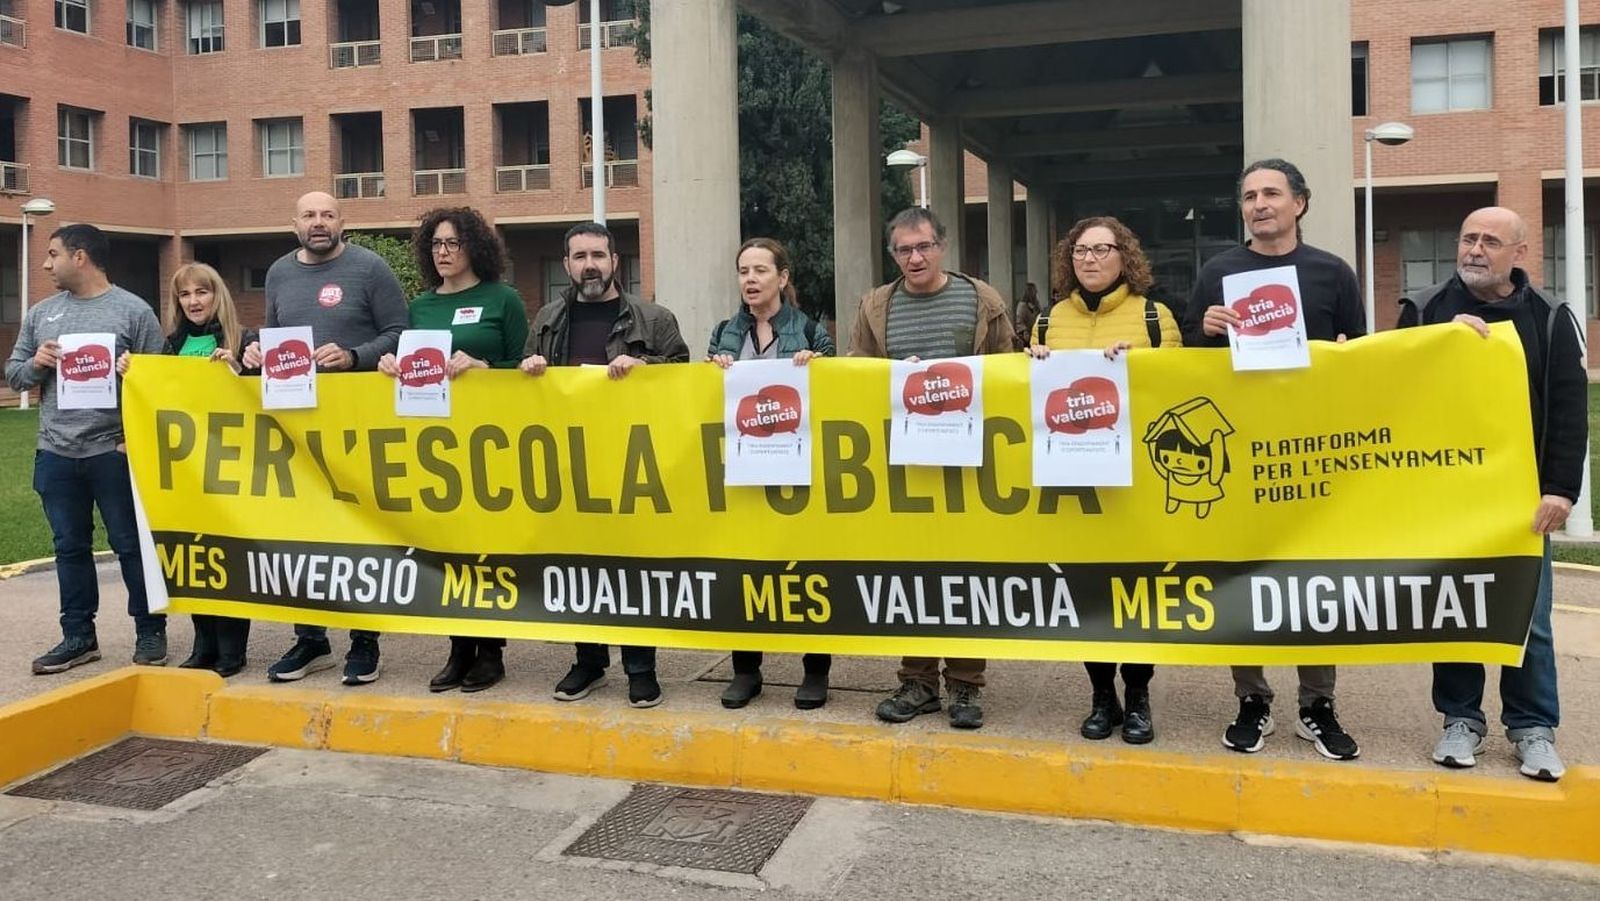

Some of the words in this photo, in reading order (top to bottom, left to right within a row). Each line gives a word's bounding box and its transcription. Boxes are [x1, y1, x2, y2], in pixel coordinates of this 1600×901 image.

[1247, 298, 1275, 314] tria
[74, 353, 95, 365] tria
[277, 350, 296, 362] tria
[411, 358, 431, 369] tria
[65, 360, 109, 375] valencià
[269, 356, 310, 374] valencià
[402, 365, 443, 380] valencià
[923, 376, 951, 390] tria
[909, 385, 970, 406] valencià
[1066, 392, 1095, 408] tria
[755, 399, 781, 413] tria
[1051, 400, 1116, 425] valencià
[741, 407, 798, 428] valencià
[1251, 427, 1392, 457] PLATAFORMA
[156, 409, 296, 498] PER
[305, 423, 673, 515] L'ESCOLA
[701, 416, 1103, 515] PBLC
[1253, 462, 1293, 481] PER
[1302, 447, 1486, 477] L'ENSENYAMENT
[1255, 481, 1331, 504] PÚBLIC
[156, 533, 228, 590] MÉS
[247, 547, 418, 605] INVERSIÓ
[441, 554, 519, 610] MÉS
[542, 565, 717, 620] QUALITAT
[742, 561, 831, 623] MÉS
[856, 562, 1081, 628] VALENCIÀ
[1110, 562, 1216, 631] MÉS
[1250, 573, 1495, 632] DIGNITAT
